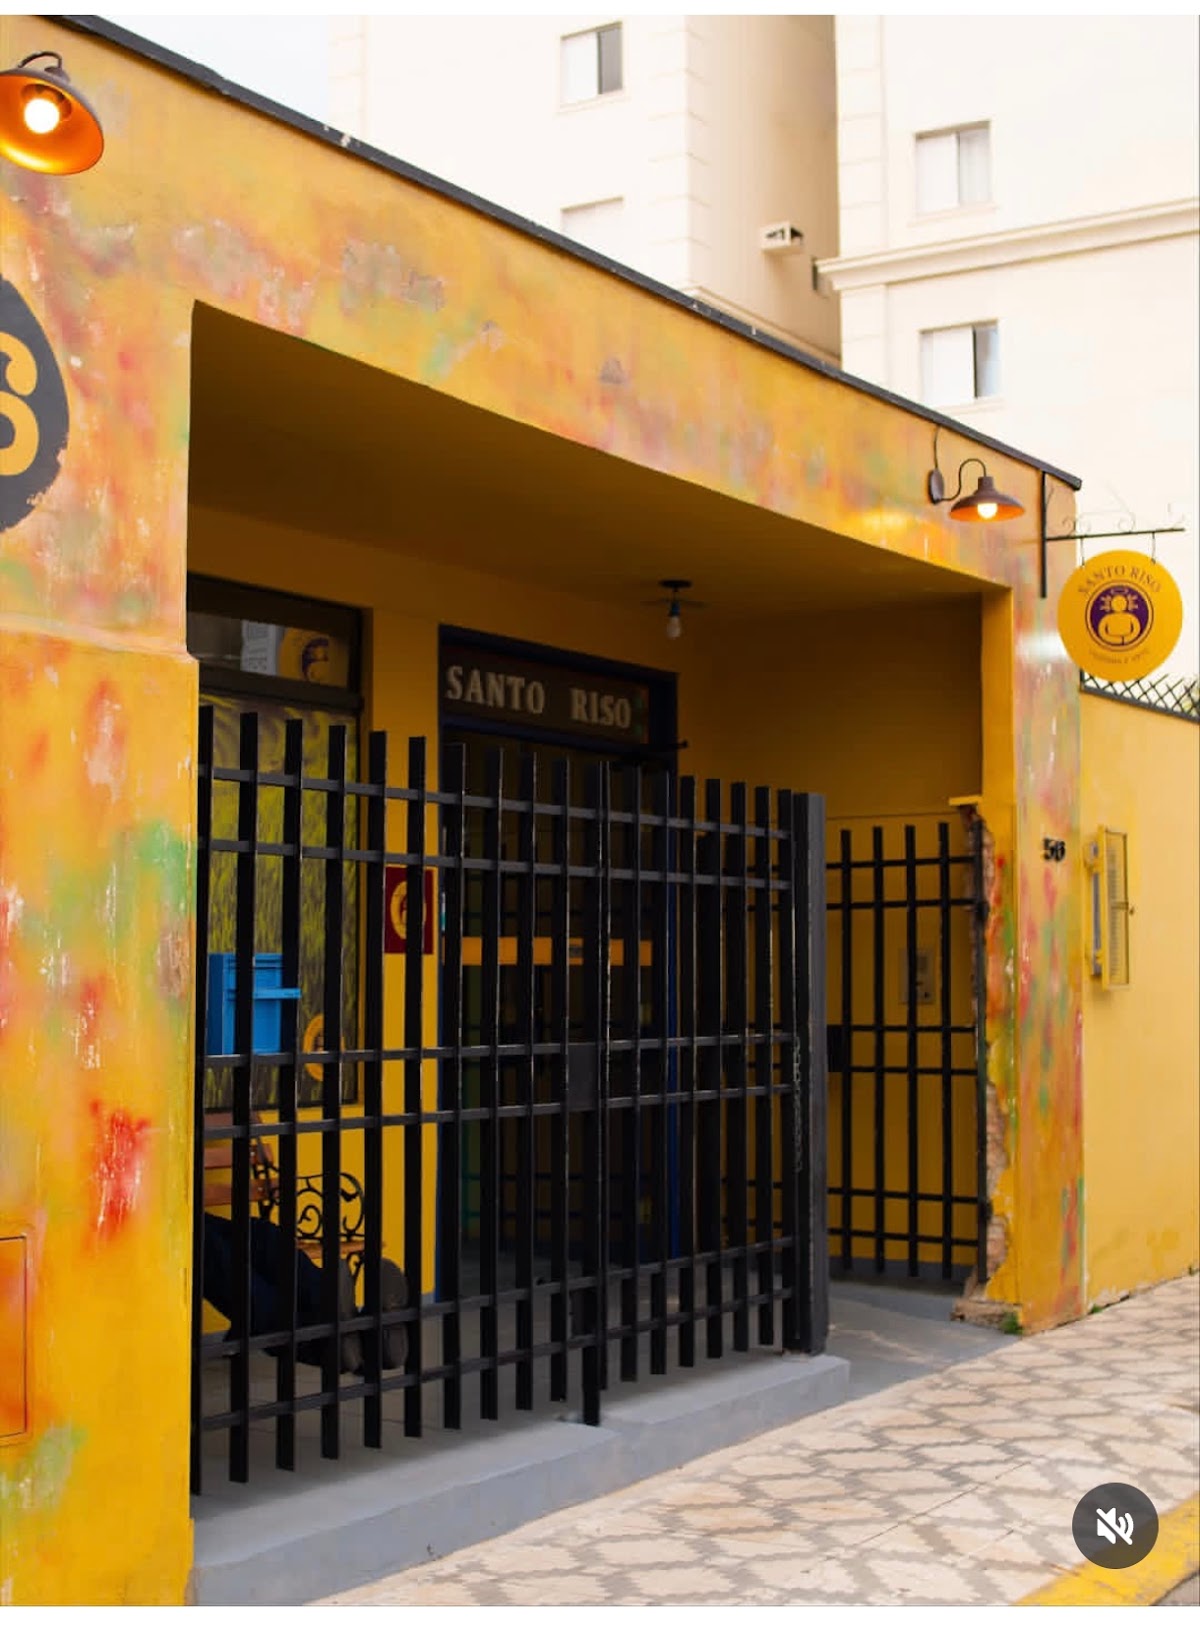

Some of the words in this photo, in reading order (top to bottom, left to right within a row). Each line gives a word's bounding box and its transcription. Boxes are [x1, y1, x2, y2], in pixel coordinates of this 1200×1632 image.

[1078, 565, 1126, 594] SANTO
[1131, 567, 1161, 593] RISO
[446, 664, 546, 714] SANTO
[569, 687, 632, 729] RISO
[1042, 838, 1066, 862] 56
